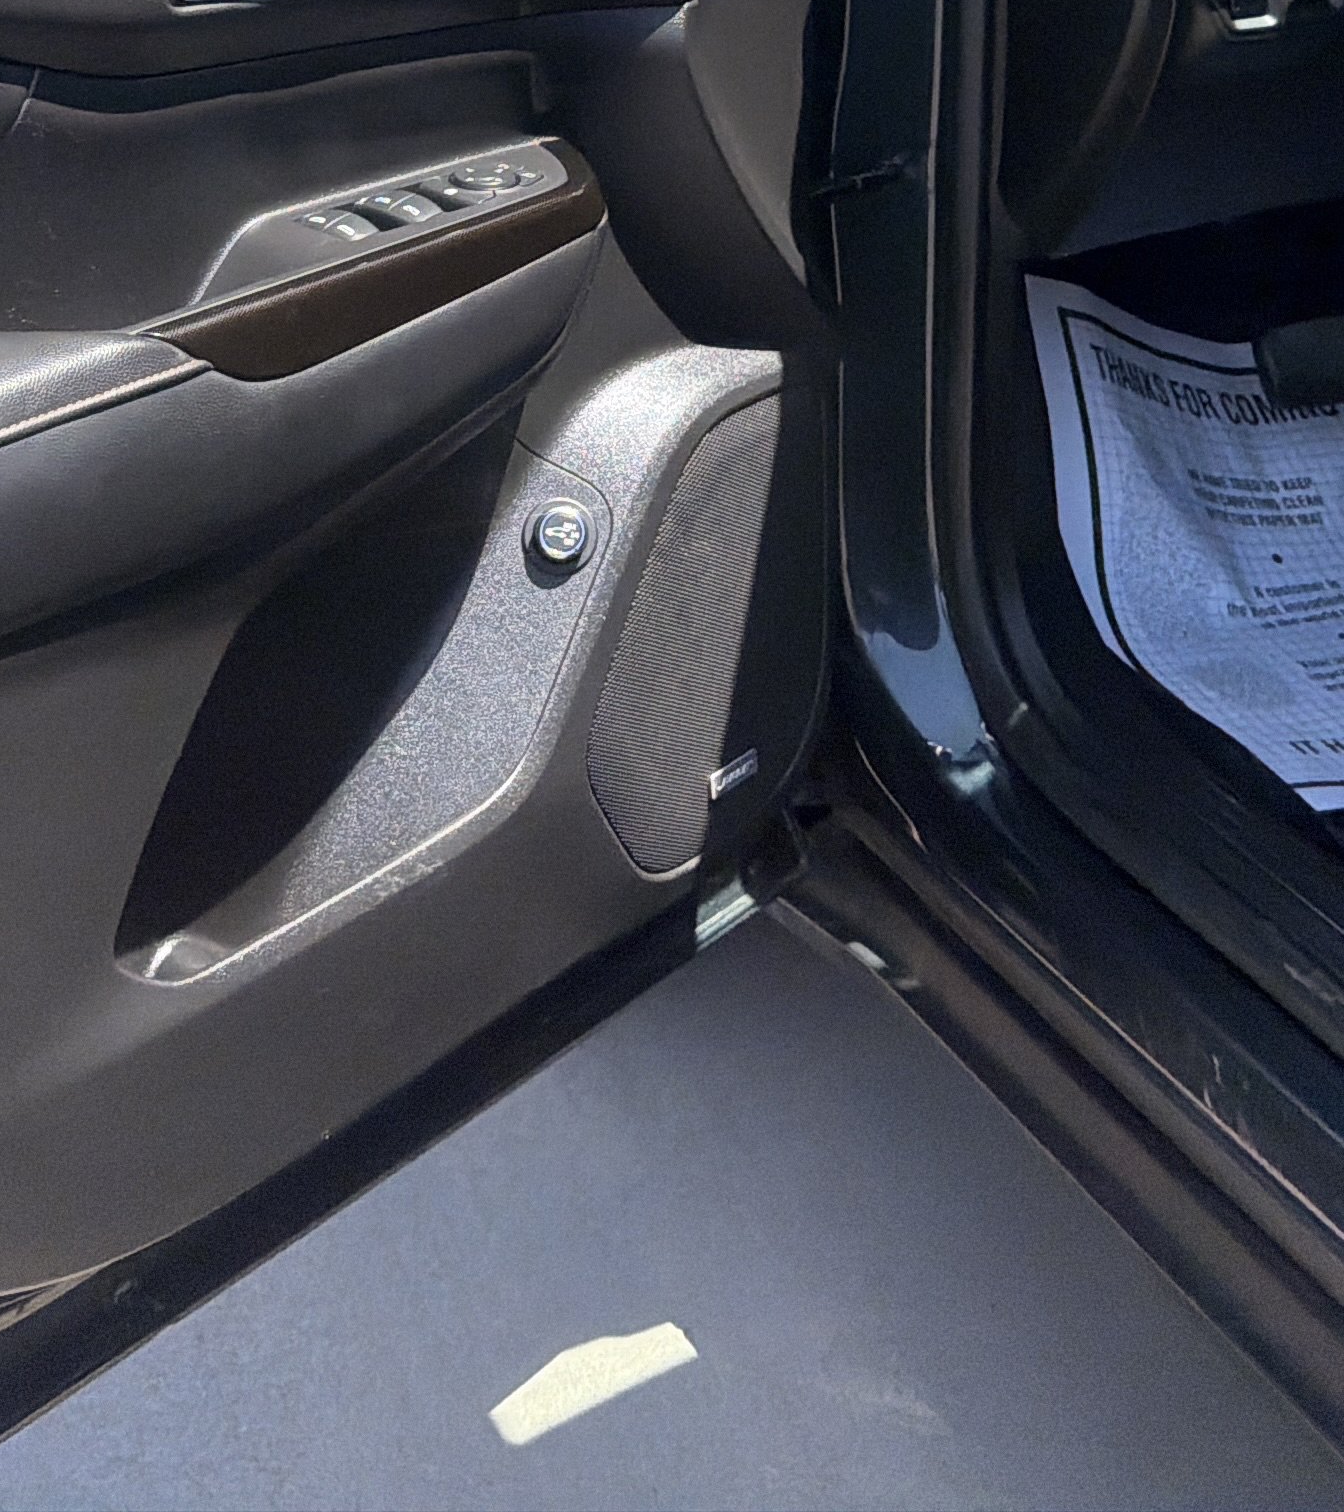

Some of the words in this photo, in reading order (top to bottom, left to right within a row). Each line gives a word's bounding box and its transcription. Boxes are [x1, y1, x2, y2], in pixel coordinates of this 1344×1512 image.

[1089, 343, 1171, 408] THANKS
[1168, 380, 1221, 420] FOR
[1288, 739, 1321, 756] IT
